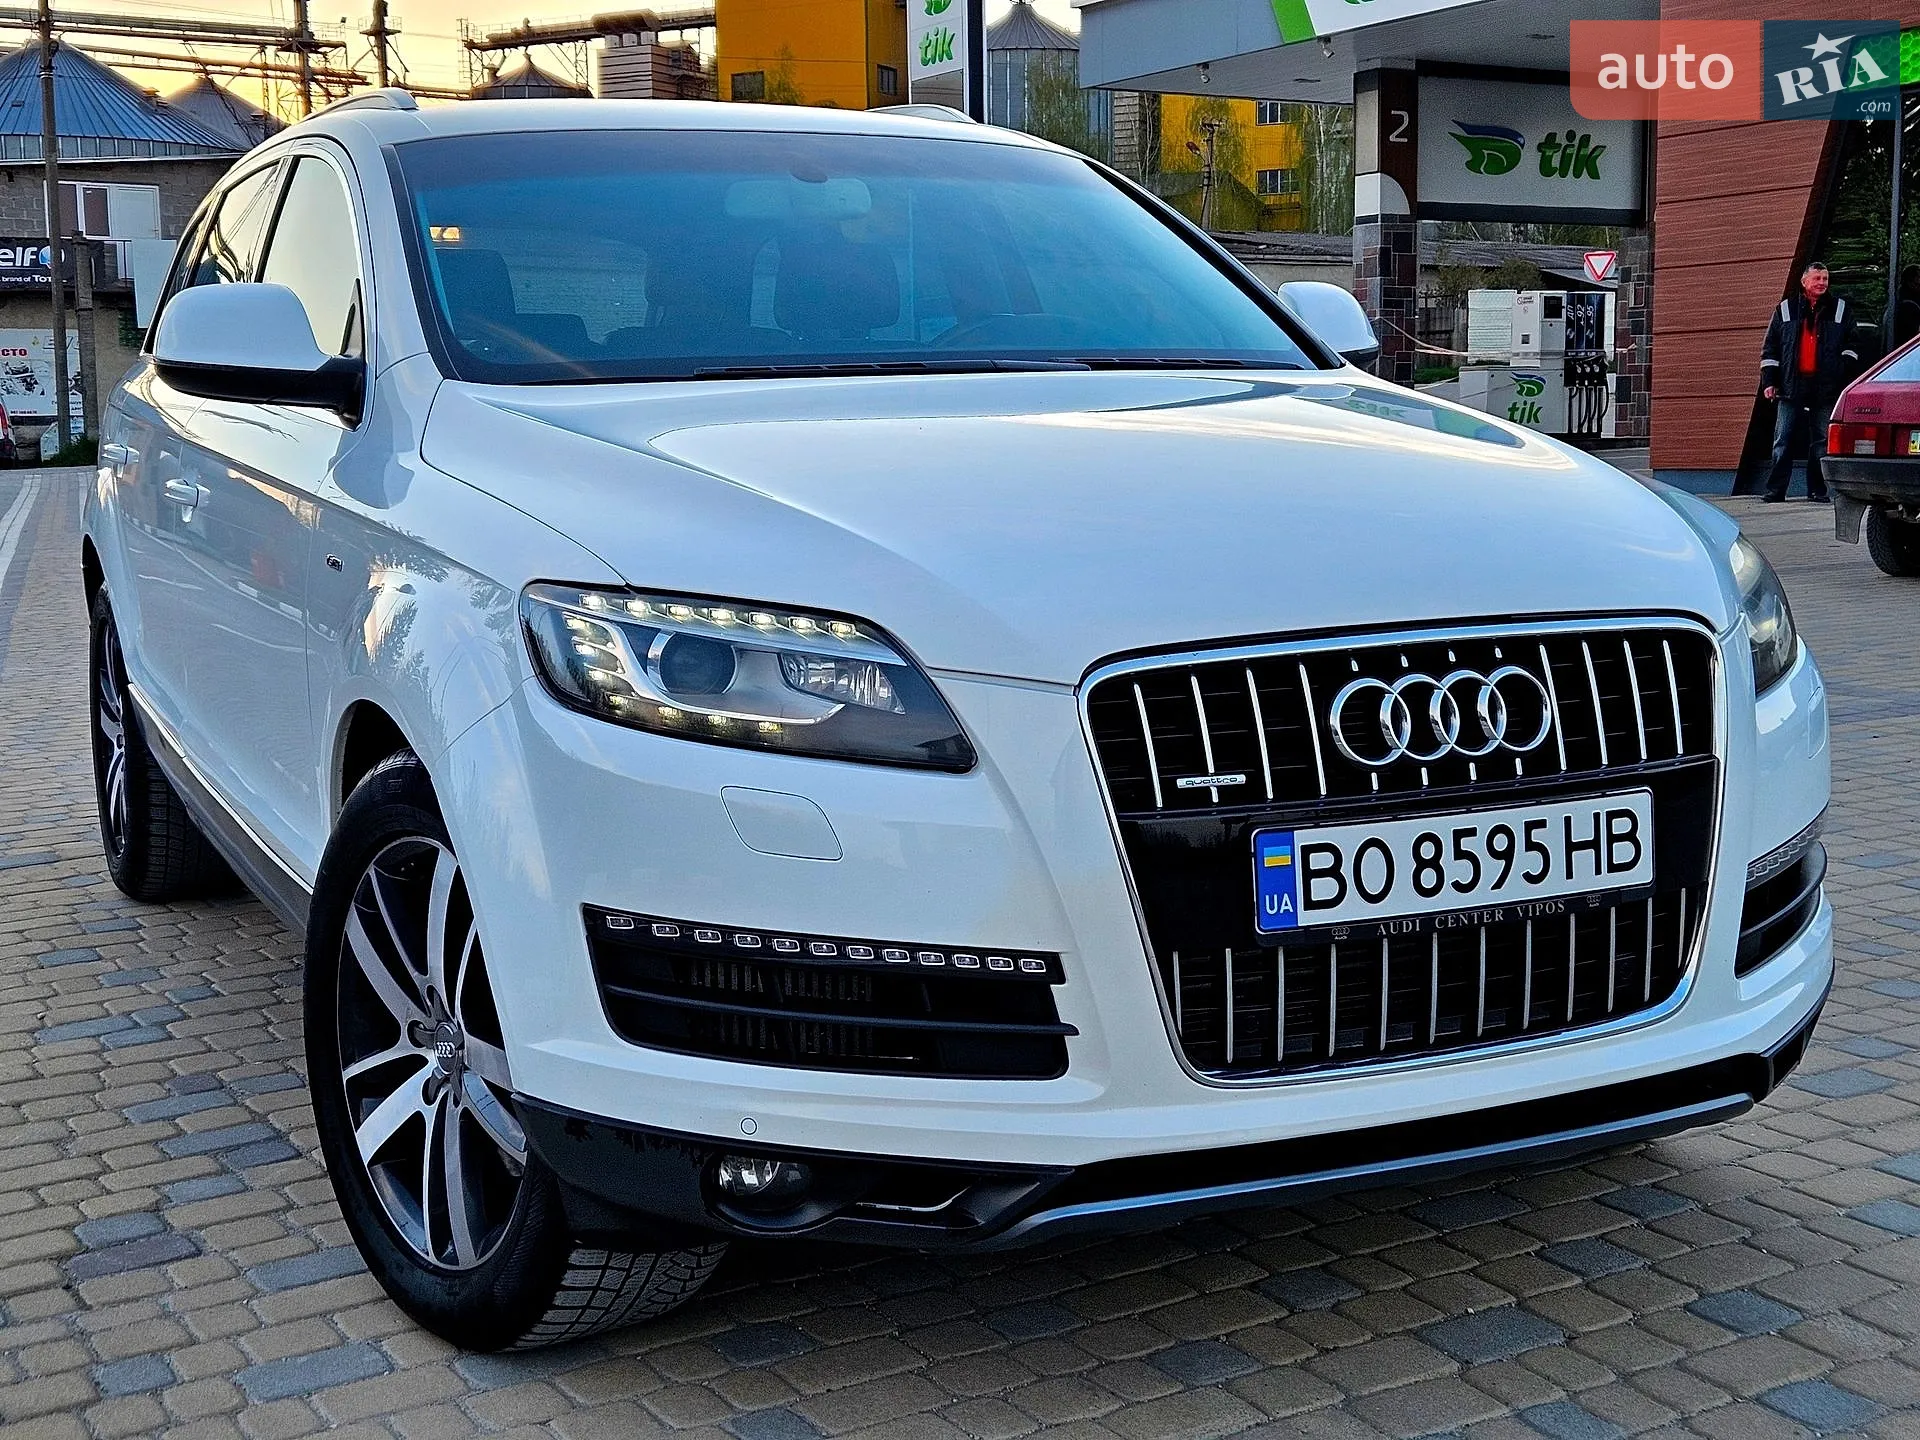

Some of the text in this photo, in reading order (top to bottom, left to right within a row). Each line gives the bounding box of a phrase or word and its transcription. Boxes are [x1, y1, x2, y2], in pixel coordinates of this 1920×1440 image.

[919, 25, 955, 66] tik
[1388, 110, 1409, 143] 2
[1537, 129, 1607, 180] tik
[0, 247, 37, 266] elf
[1507, 401, 1544, 424] tik
[1185, 776, 1238, 786] quattro
[1300, 807, 1642, 912] BO 8595 HB
[1265, 893, 1293, 914] UA
[1377, 900, 1565, 936] AUDI CENTER VIPOS
